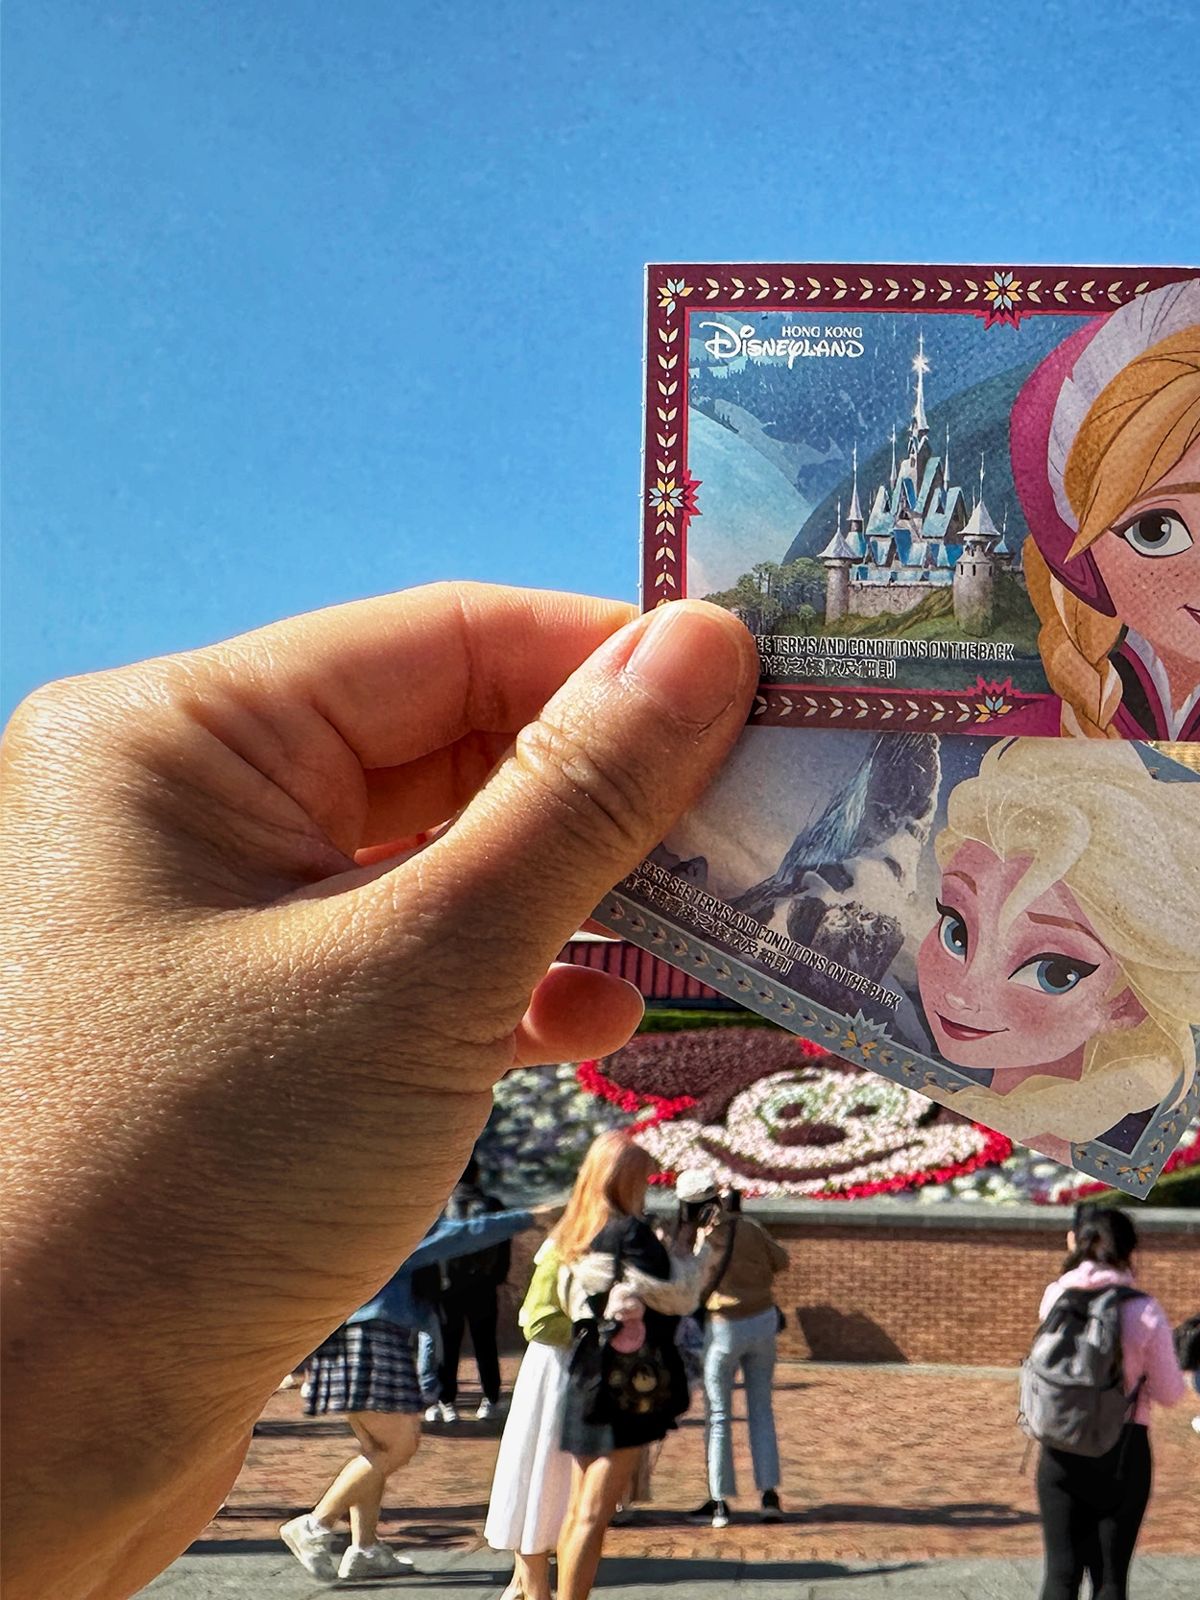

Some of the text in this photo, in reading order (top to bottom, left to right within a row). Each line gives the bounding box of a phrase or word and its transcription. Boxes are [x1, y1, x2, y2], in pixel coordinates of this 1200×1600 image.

[781, 326, 863, 338] HONG KONG
[753, 634, 1014, 661] EE TERMS AND CONDITIONS ON THE BACK
[669, 876, 693, 900] SEE
[692, 888, 734, 921] TERMS
[730, 911, 759, 937] AND
[757, 924, 828, 972] CONDITIONS
[825, 961, 847, 983] ON
[843, 970, 871, 995] THE
[869, 982, 903, 1012] BACK
